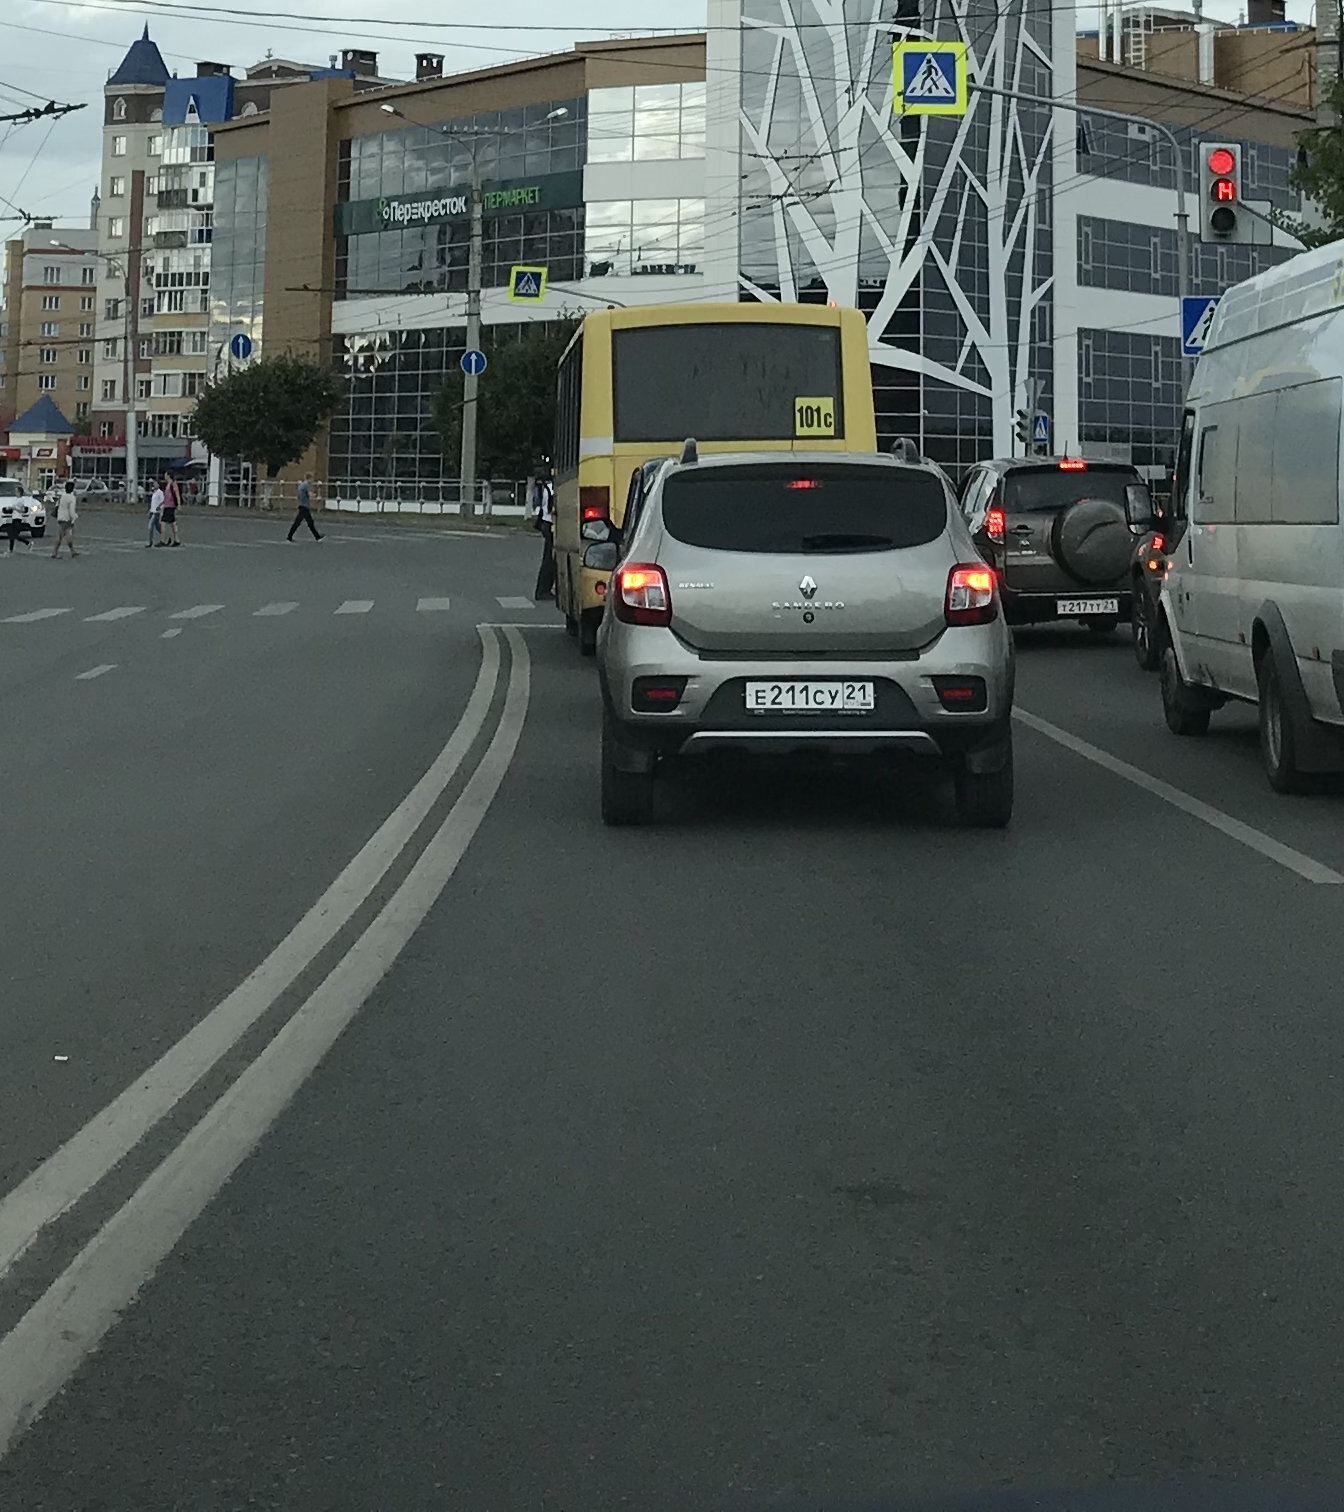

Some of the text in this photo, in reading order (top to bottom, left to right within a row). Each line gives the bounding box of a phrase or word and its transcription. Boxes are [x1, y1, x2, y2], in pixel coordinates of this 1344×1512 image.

[389, 186, 541, 225] Перекресток ПЕРМАРКЕТ
[771, 601, 846, 610] SANDERO
[845, 683, 867, 701] 21
